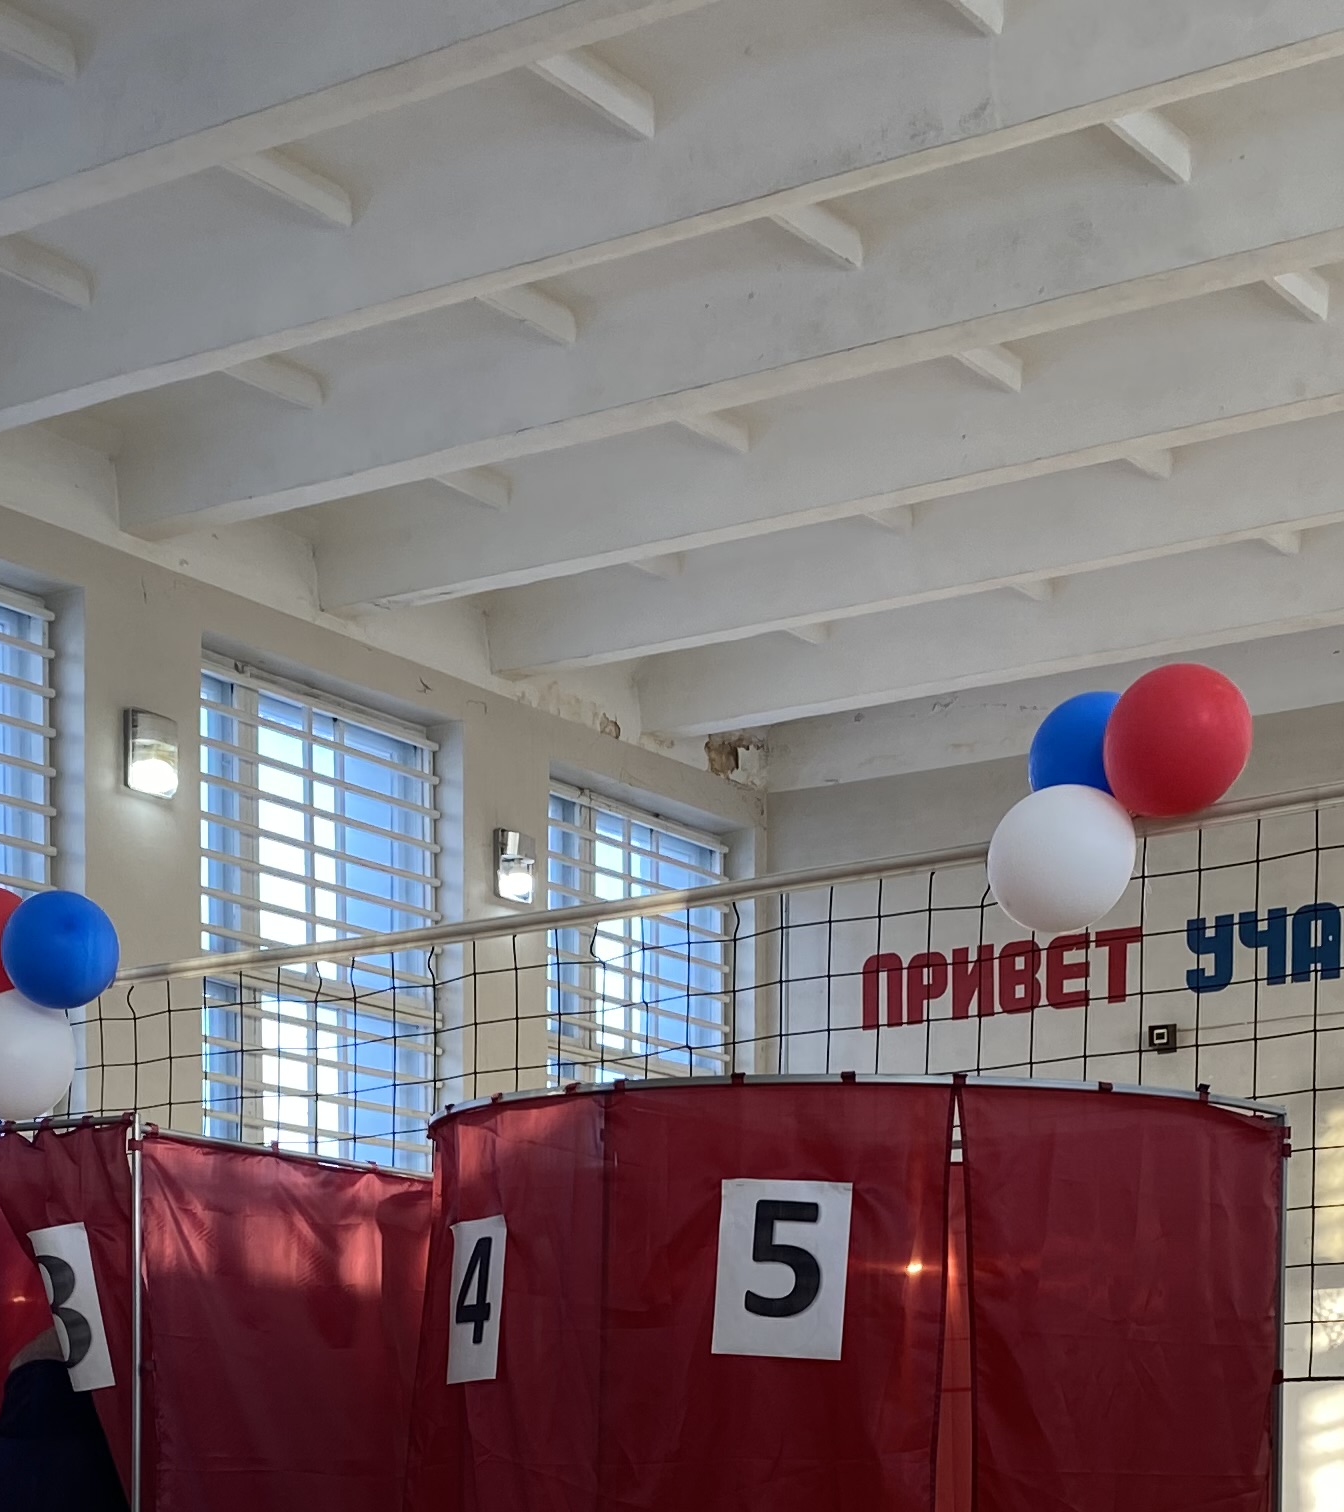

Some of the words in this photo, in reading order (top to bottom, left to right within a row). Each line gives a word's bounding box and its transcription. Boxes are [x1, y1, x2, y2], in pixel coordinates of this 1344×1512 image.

[862, 926, 1142, 1031] ПРИВЕТ
[456, 1237, 493, 1344] 4
[744, 1199, 821, 1318] 5
